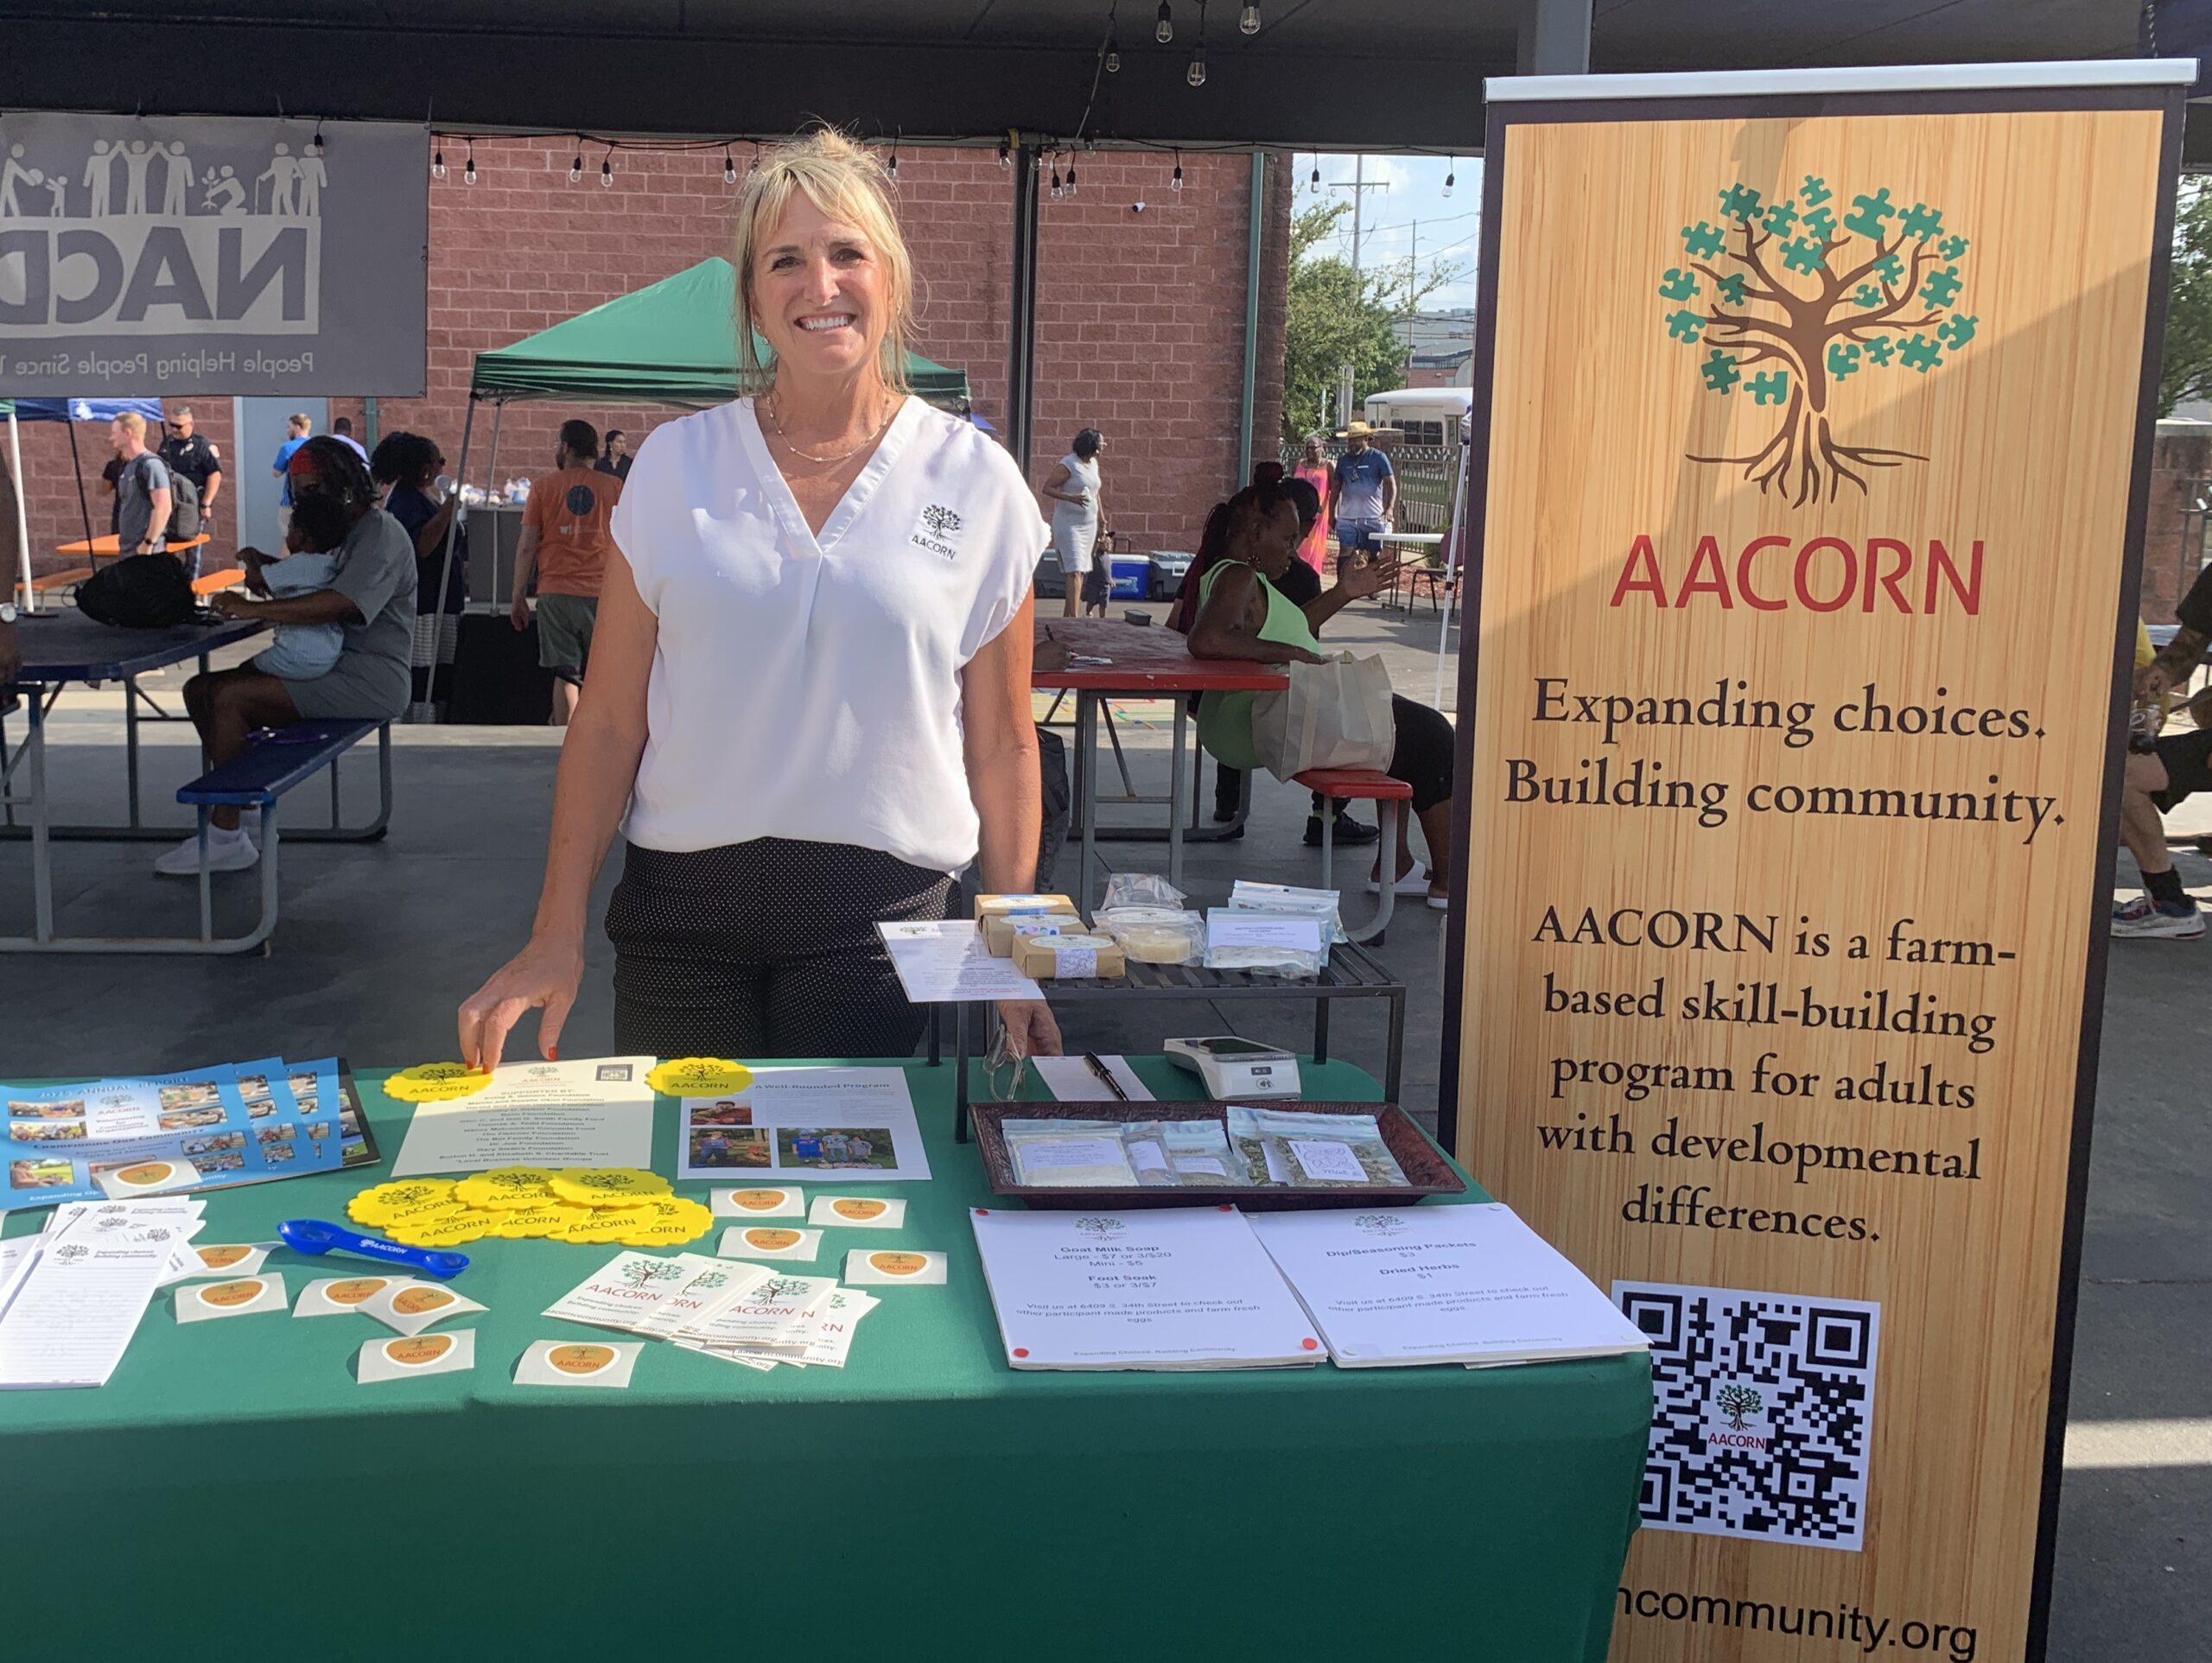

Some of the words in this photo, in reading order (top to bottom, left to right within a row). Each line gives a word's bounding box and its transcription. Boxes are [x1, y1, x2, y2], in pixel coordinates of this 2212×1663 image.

[911, 535, 956, 560] AACORN
[1610, 535, 1984, 615] AACORN
[1532, 677, 1815, 748] Expanding
[1834, 683, 2046, 738] choices.
[1504, 759, 1729, 828] Building
[1747, 775, 2065, 844] community.
[1531, 905, 1779, 953] AACORN
[1795, 916, 1830, 958] is
[1847, 935, 1869, 959] a
[1886, 920, 2017, 967] farm-
[1544, 973, 1665, 1018] based
[1682, 980, 1997, 1054] skill-building
[1551, 1057, 1734, 1100] program
[1751, 1054, 1820, 1097] for
[1834, 1062, 1975, 1108] adults
[79, 1085, 131, 1095] ANNUAL
[409, 1085, 469, 1095] AACORN
[1538, 1113, 1636, 1155] with
[1651, 1119, 1982, 1184] developmental
[488, 1192, 555, 1201] AACORN
[591, 1190, 655, 1199] AACORN
[1622, 1184, 1880, 1242] differences.
[420, 1218, 491, 1238] AACORN
[569, 1219, 636, 1233] AACORN
[371, 1243, 407, 1253] AACORN
[1326, 1245, 1422, 1257] Dip/Seasoning
[213, 1292, 253, 1303] AACORN
[586, 1285, 663, 1300] AACORN
[1357, 1304, 1412, 1312] participant
[1446, 1297, 1491, 1305] products
[397, 1349, 440, 1359] AACORN
[556, 1359, 600, 1369] AACORN
[1708, 1432, 1765, 1449] AACORN
